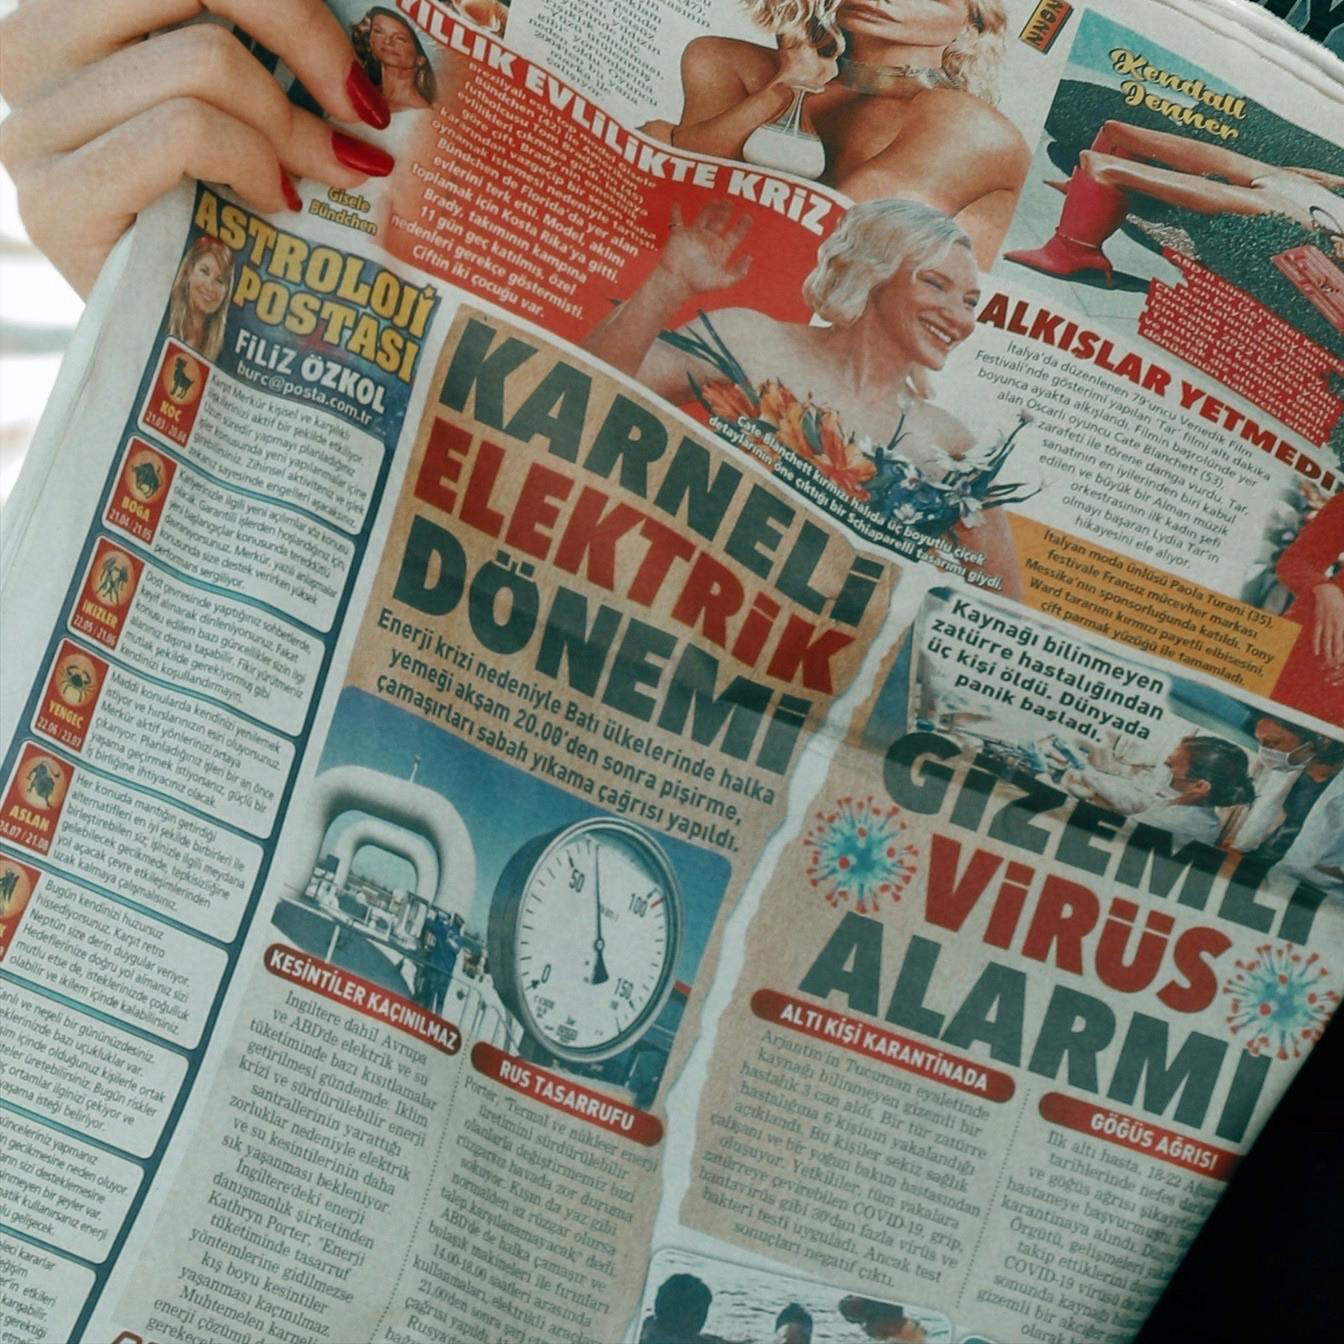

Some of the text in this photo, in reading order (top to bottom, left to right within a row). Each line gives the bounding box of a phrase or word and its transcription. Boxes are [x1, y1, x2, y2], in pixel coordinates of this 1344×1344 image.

[1107, 44, 1250, 121] Kendall
[521, 63, 718, 187] EVLİLİKTE
[727, 163, 832, 235] KRİZ
[232, 265, 422, 383] POSTASI
[233, 328, 390, 413] FİLİZ ÖZKOL
[235, 361, 373, 426] burc@posta.com.tr
[438, 319, 884, 628] KARNELİ
[761, 432, 814, 476] Blanchett
[829, 498, 849, 518] bir
[410, 416, 855, 695] ELEKTRİK
[1088, 546, 1125, 570] moda
[1168, 578, 1205, 601] Paola
[393, 514, 811, 777] DÖNEMİ
[925, 637, 953, 662] üç
[954, 648, 998, 680] kişi
[1057, 687, 1152, 741] Dünyada
[930, 616, 1166, 722] zatürre hastalığından
[950, 598, 1167, 697] Kaynağı bilinmeyen
[953, 671, 1016, 708] panik
[371, 671, 479, 740] çamaşırları
[474, 720, 532, 766] sabah
[529, 747, 599, 796] yıkama
[596, 777, 669, 827] çağrısı
[375, 607, 778, 808] Enerji krizi nedeniyle Batı ülkelerinde halka
[385, 647, 455, 699] yemeği
[451, 680, 514, 726] akşam
[511, 708, 602, 767] 20.00'den
[598, 748, 661, 792] sonra
[9, 803, 50, 832] ASLAN
[570, 869, 584, 893] 50
[630, 893, 648, 918] 100
[925, 832, 1235, 1020] VİRÜS
[269, 947, 367, 1008] KESİNTİLER
[363, 991, 460, 1051] KAÇINILMAZ
[541, 964, 551, 984] 0
[616, 978, 634, 1000] 150
[780, 1003, 825, 1032] ALTI
[861, 1030, 989, 1092] KARANTİNADA
[798, 911, 1273, 1146] ALARMI
[497, 1059, 637, 1132] RUS TASARRUFU
[1089, 1109, 1219, 1170] GÖĞÜS AĞRISI
